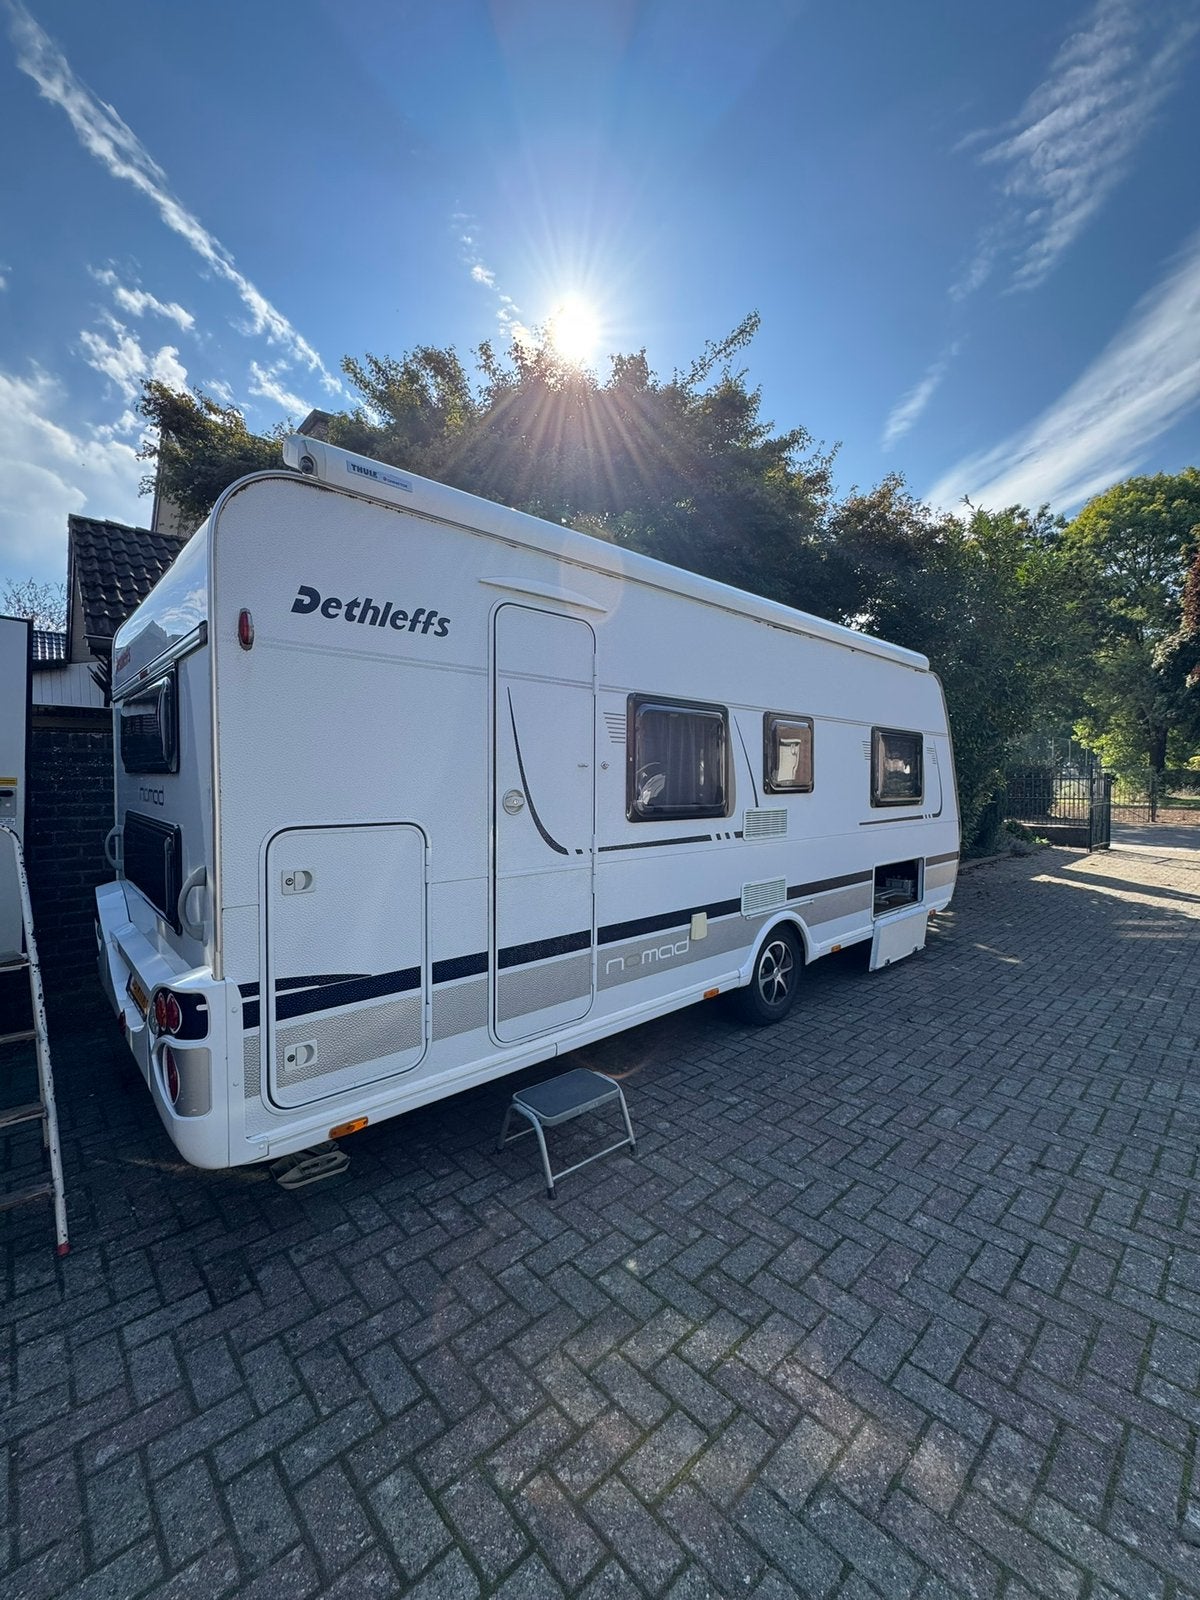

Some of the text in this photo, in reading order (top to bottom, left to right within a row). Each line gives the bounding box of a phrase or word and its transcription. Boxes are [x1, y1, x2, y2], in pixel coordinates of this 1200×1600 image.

[351, 463, 378, 479] THULE
[291, 585, 450, 637] Dethleffs
[606, 935, 689, 975] nomad
